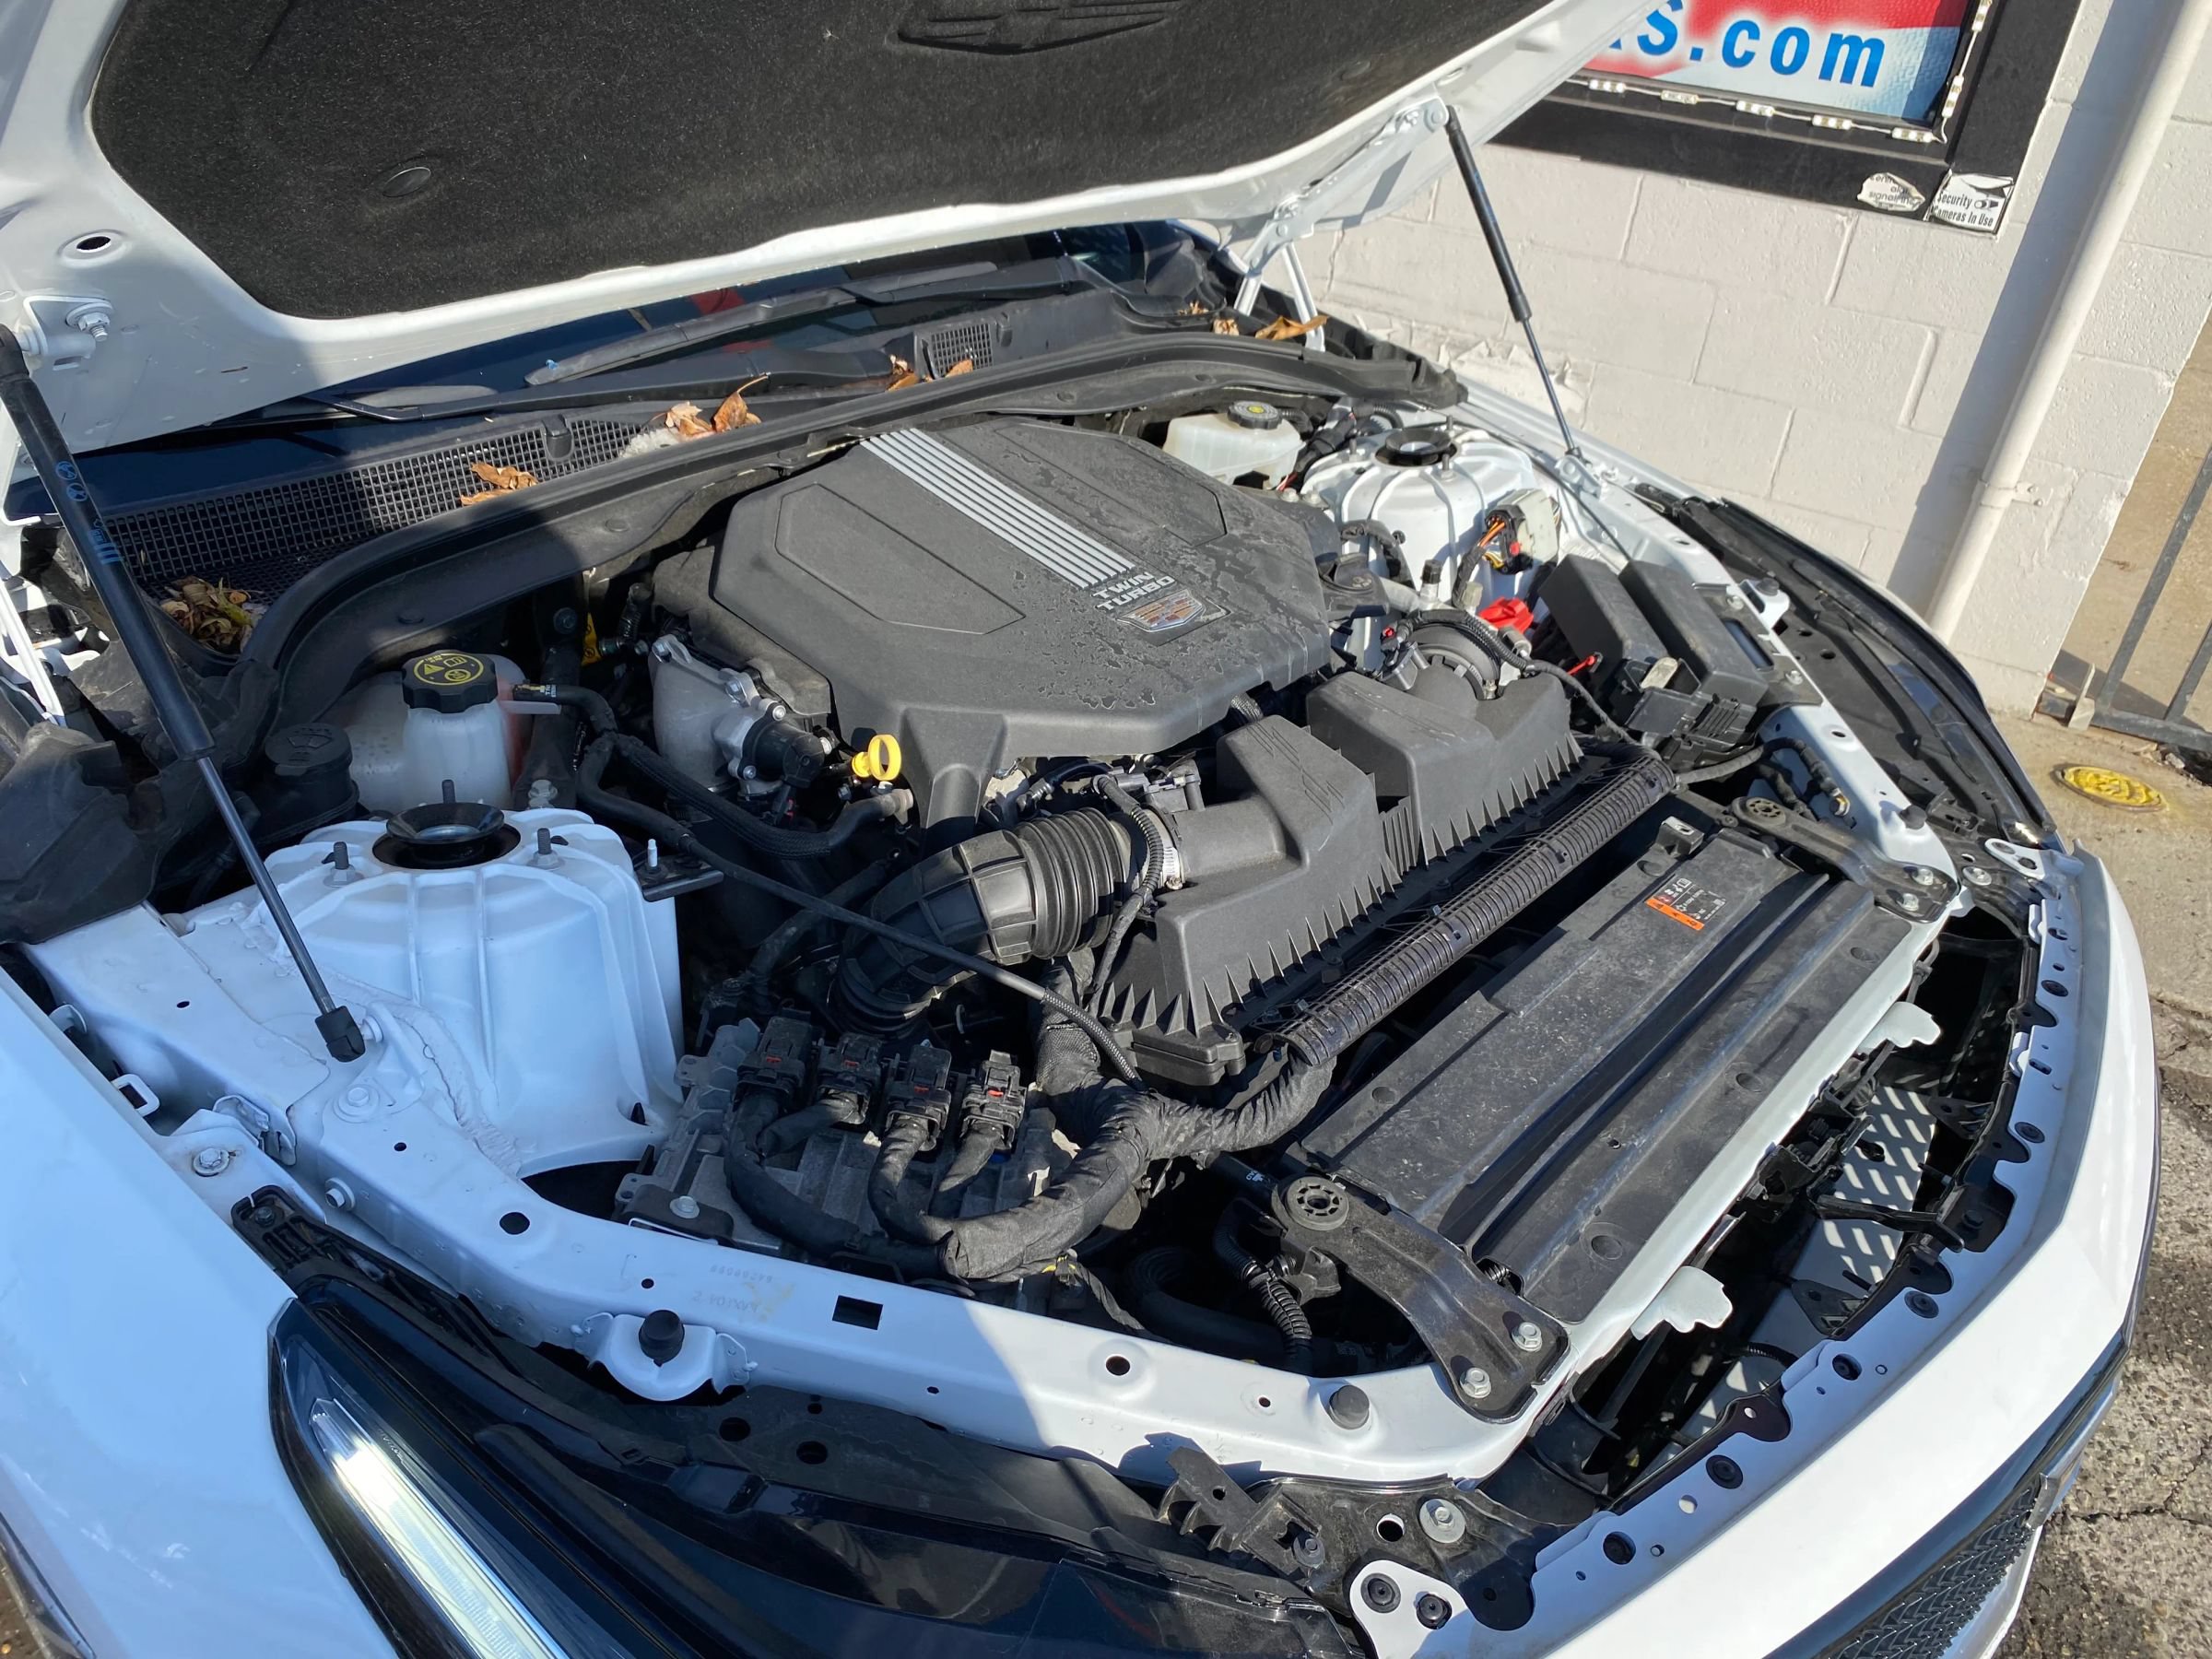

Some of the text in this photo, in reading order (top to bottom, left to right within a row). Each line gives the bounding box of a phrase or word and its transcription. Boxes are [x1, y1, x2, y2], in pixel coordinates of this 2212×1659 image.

[1936, 190, 1972, 210] Security
[1968, 211, 1978, 225] In
[1978, 213, 1994, 227] Use
[1091, 571, 1156, 600] TWIN
[1096, 574, 1177, 611] TURBO
